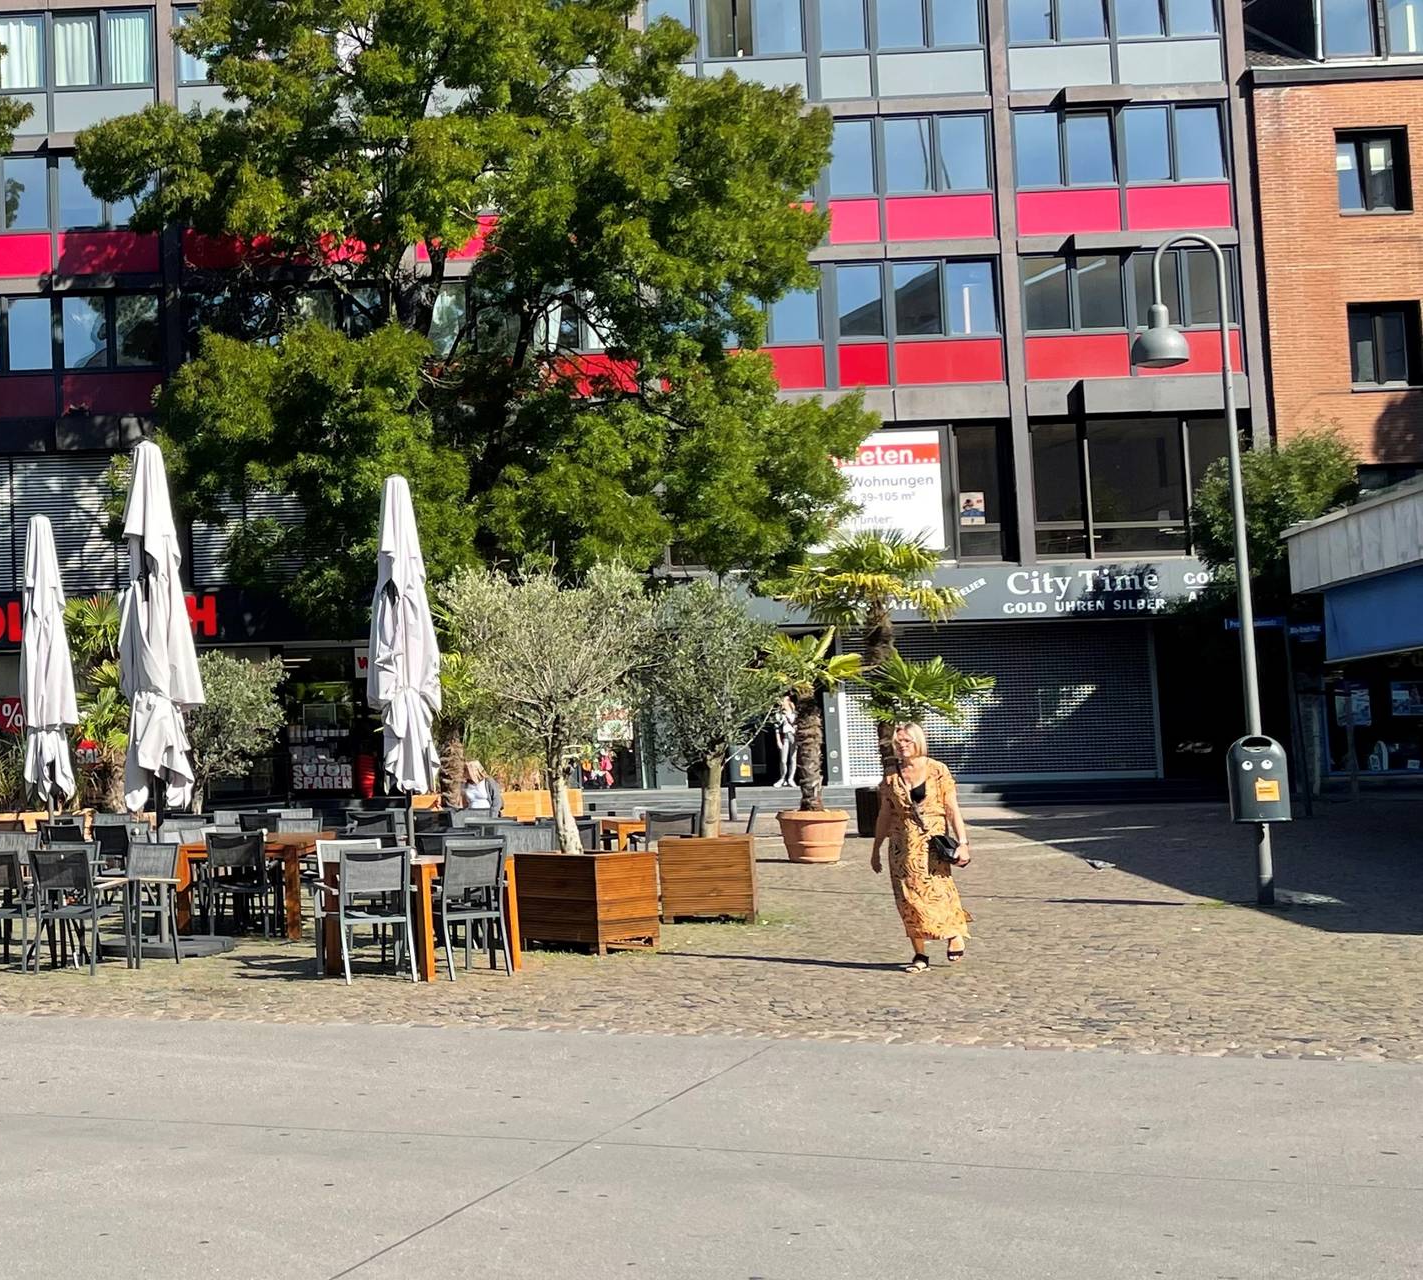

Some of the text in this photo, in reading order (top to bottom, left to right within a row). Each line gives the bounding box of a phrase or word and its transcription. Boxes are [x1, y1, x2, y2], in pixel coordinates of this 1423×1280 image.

[851, 475, 934, 489] Wohnungen
[861, 491, 899, 502] 39-105
[1006, 568, 1159, 601] City Time
[1003, 598, 1166, 614] GOLD UHREN SILBER
[293, 776, 353, 789] SPAREN
